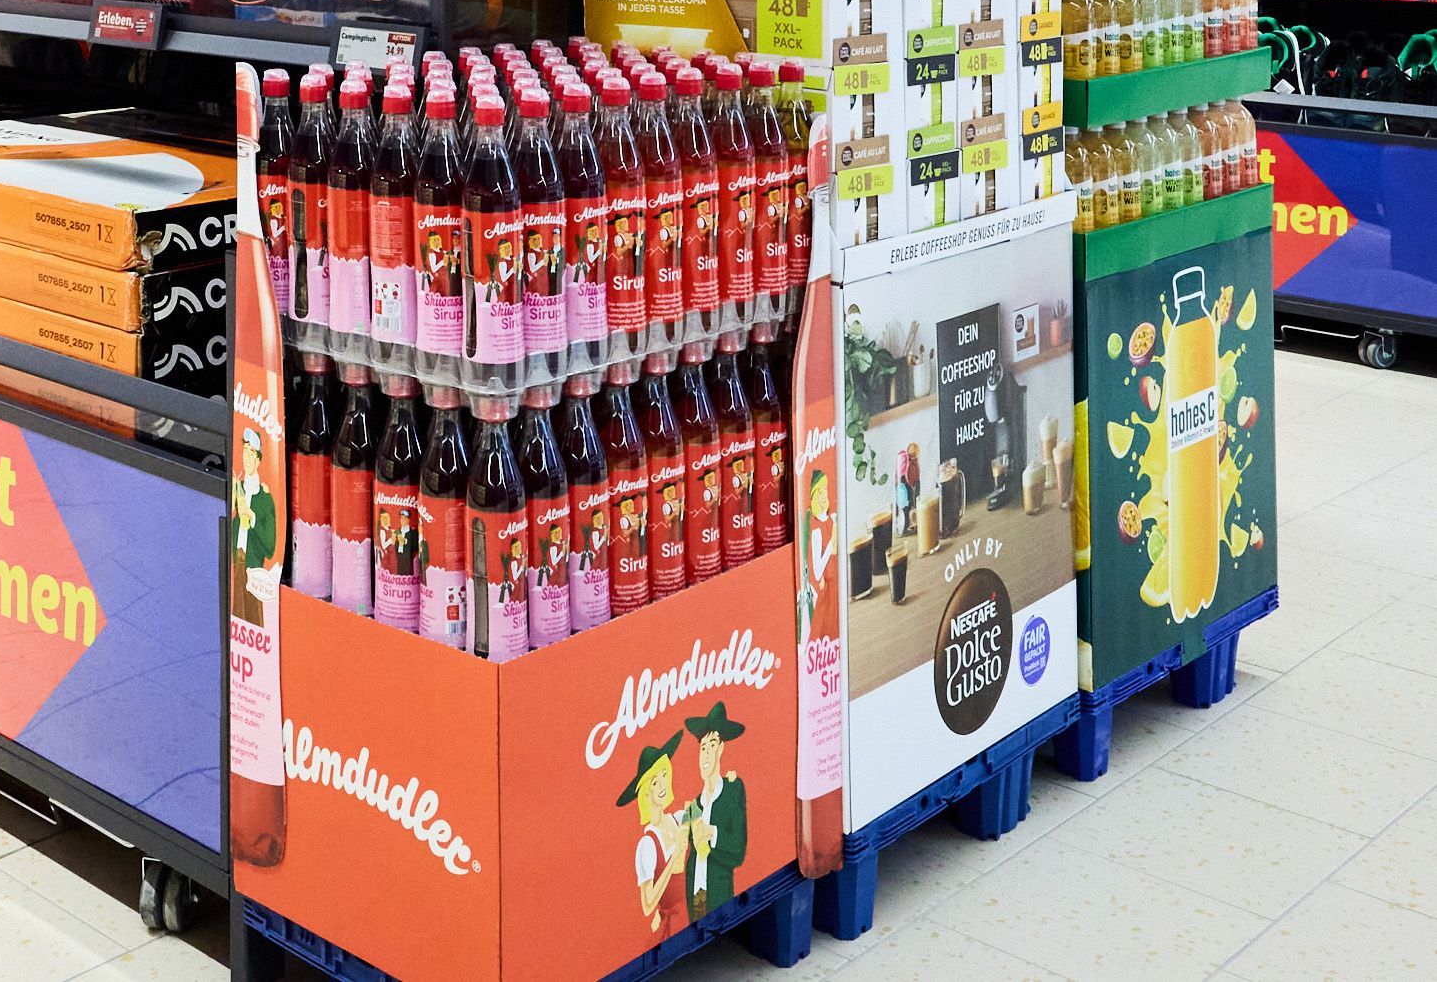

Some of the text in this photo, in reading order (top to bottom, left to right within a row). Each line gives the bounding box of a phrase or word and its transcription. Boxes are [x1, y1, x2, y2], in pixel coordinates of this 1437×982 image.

[618, 3, 685, 15] IN JEDER TASSE
[342, 32, 377, 43] Campingtisch
[386, 45, 404, 56] 34.99
[35, 212, 91, 233] 507855_2507
[958, 322, 978, 344] DEIN
[941, 349, 996, 384] COFFEESHOP
[954, 386, 985, 413] FÜR ZU
[1171, 401, 1206, 437] hohes
[1208, 391, 1215, 422] C
[956, 417, 984, 446] HAUSE
[944, 537, 1003, 582] ONLY BY
[230, 620, 272, 654] asser
[1023, 623, 1046, 650] FAIR
[945, 624, 1002, 679] Dolce
[821, 670, 840, 698] Sir
[946, 654, 1002, 707] Gusto
[585, 628, 776, 770] Almdudler
[282, 718, 472, 876] Almdudler
